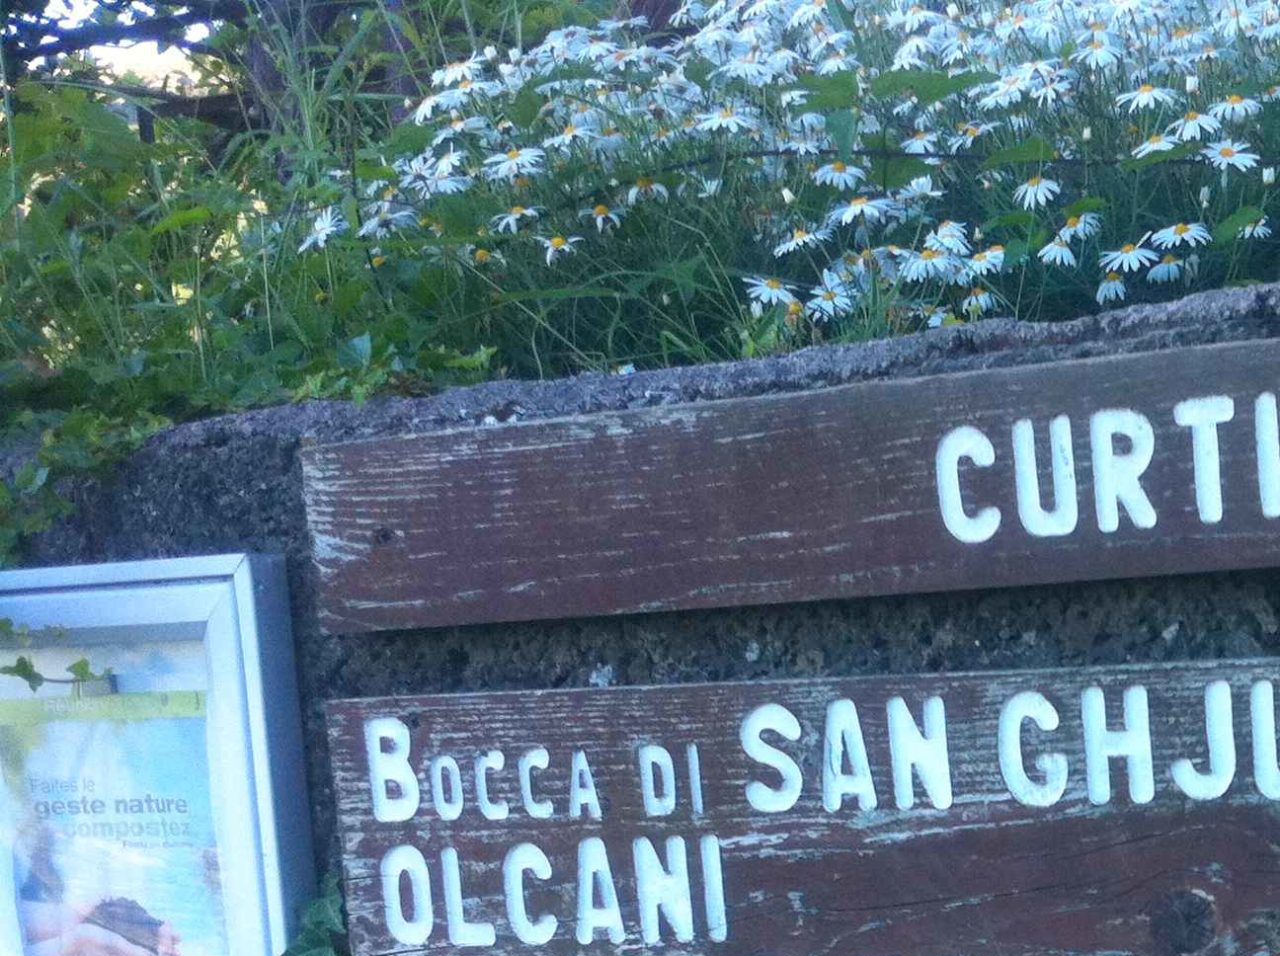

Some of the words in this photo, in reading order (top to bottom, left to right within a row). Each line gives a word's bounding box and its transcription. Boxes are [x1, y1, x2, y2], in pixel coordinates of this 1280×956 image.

[34, 796, 106, 820] geste
[114, 793, 189, 815] nature
[739, 696, 954, 814] SAN
[379, 834, 728, 947] OLCANI
